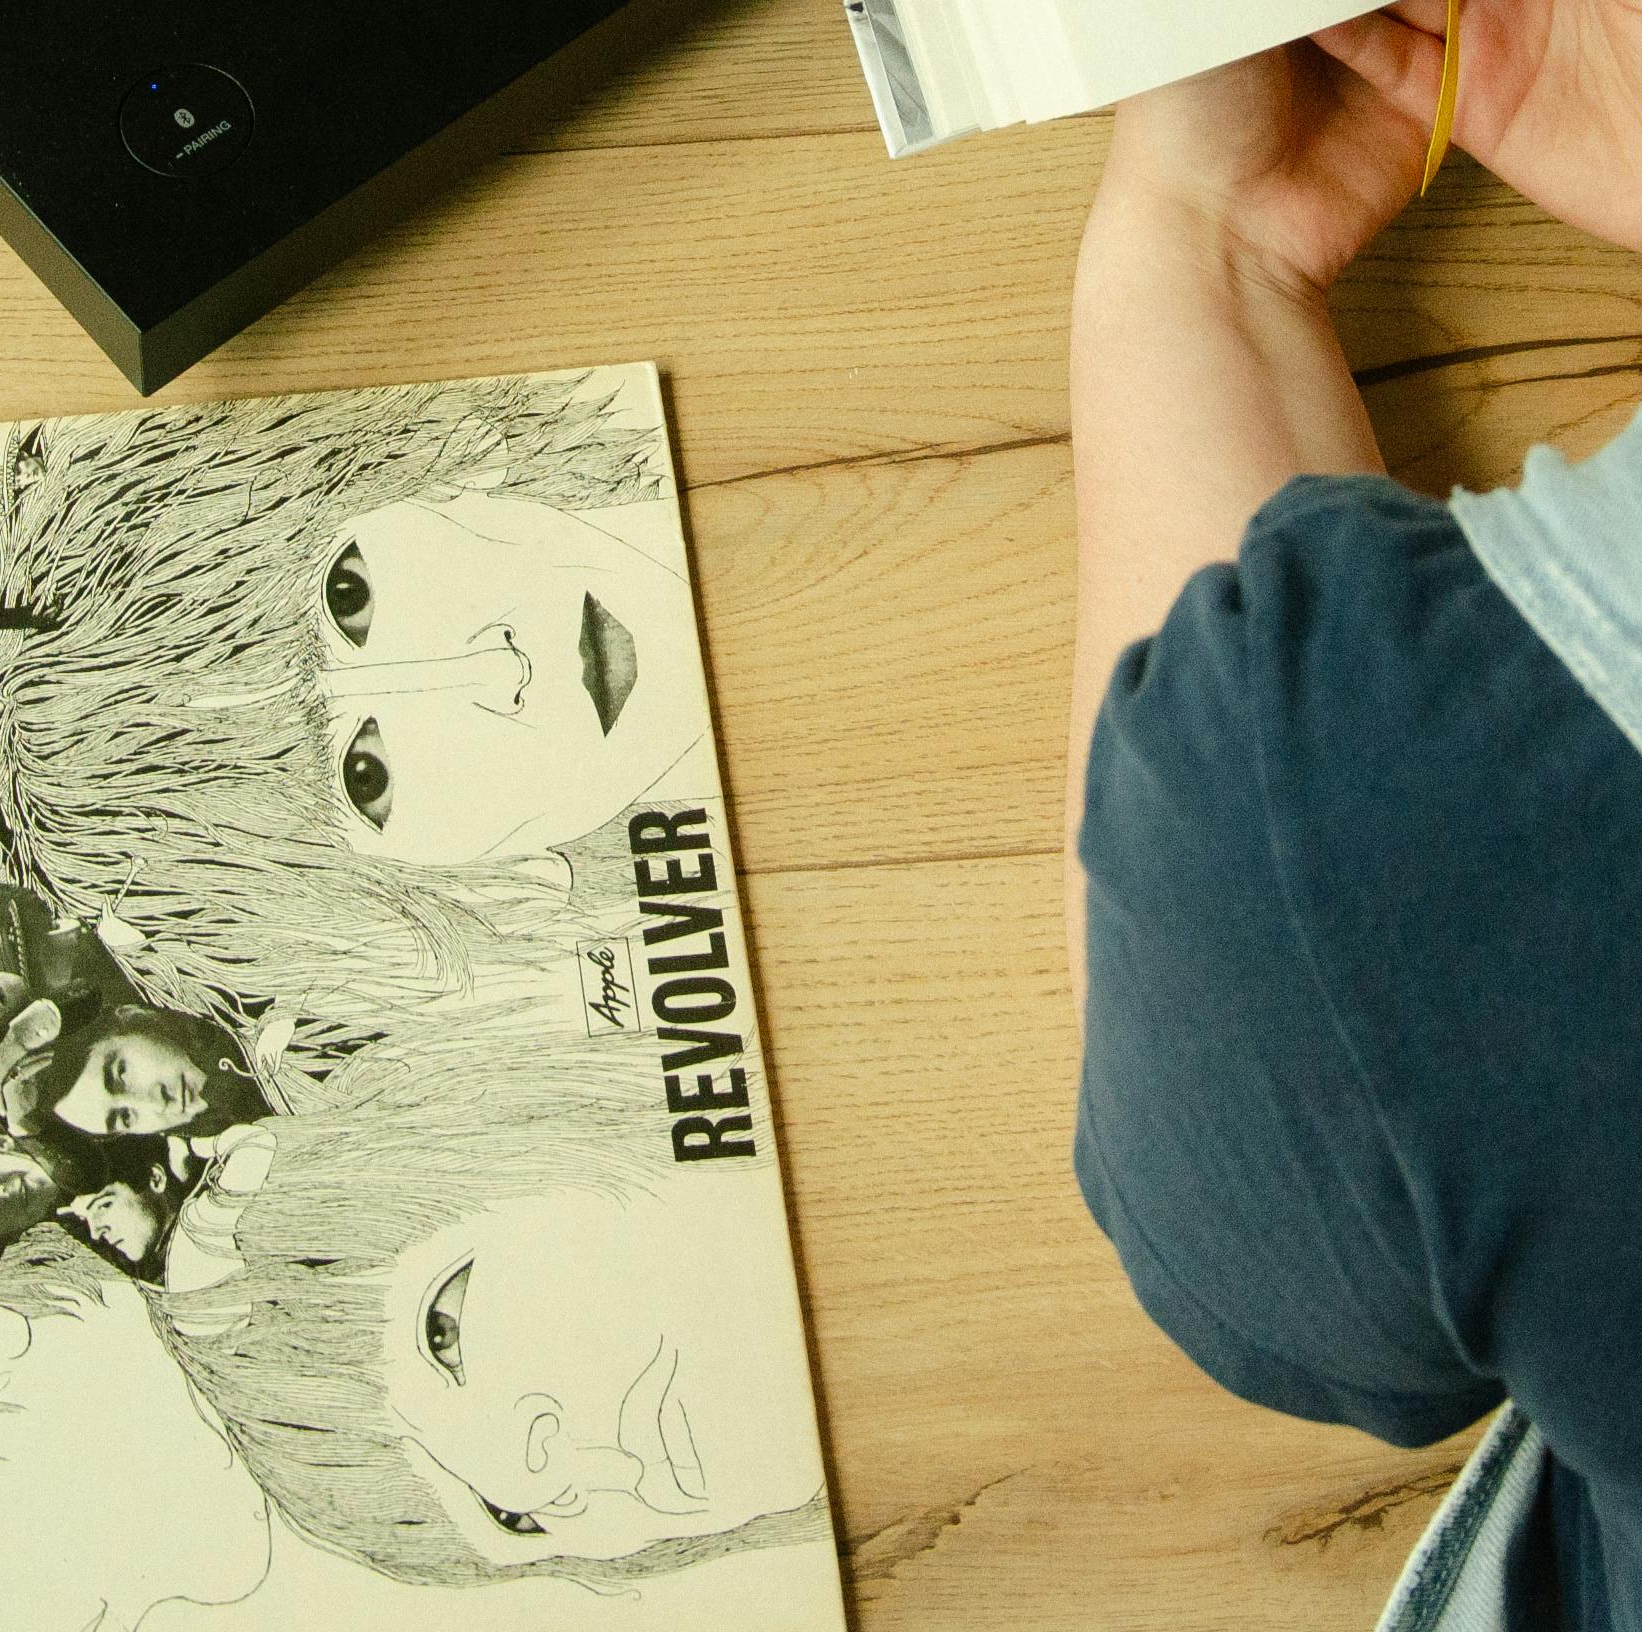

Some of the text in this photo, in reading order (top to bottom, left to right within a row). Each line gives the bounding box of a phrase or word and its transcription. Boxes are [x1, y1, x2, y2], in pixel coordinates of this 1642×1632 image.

[183, 120, 232, 156] PAIRING
[588, 946, 631, 1028] Apple
[628, 807, 757, 1163] REVOLVER
